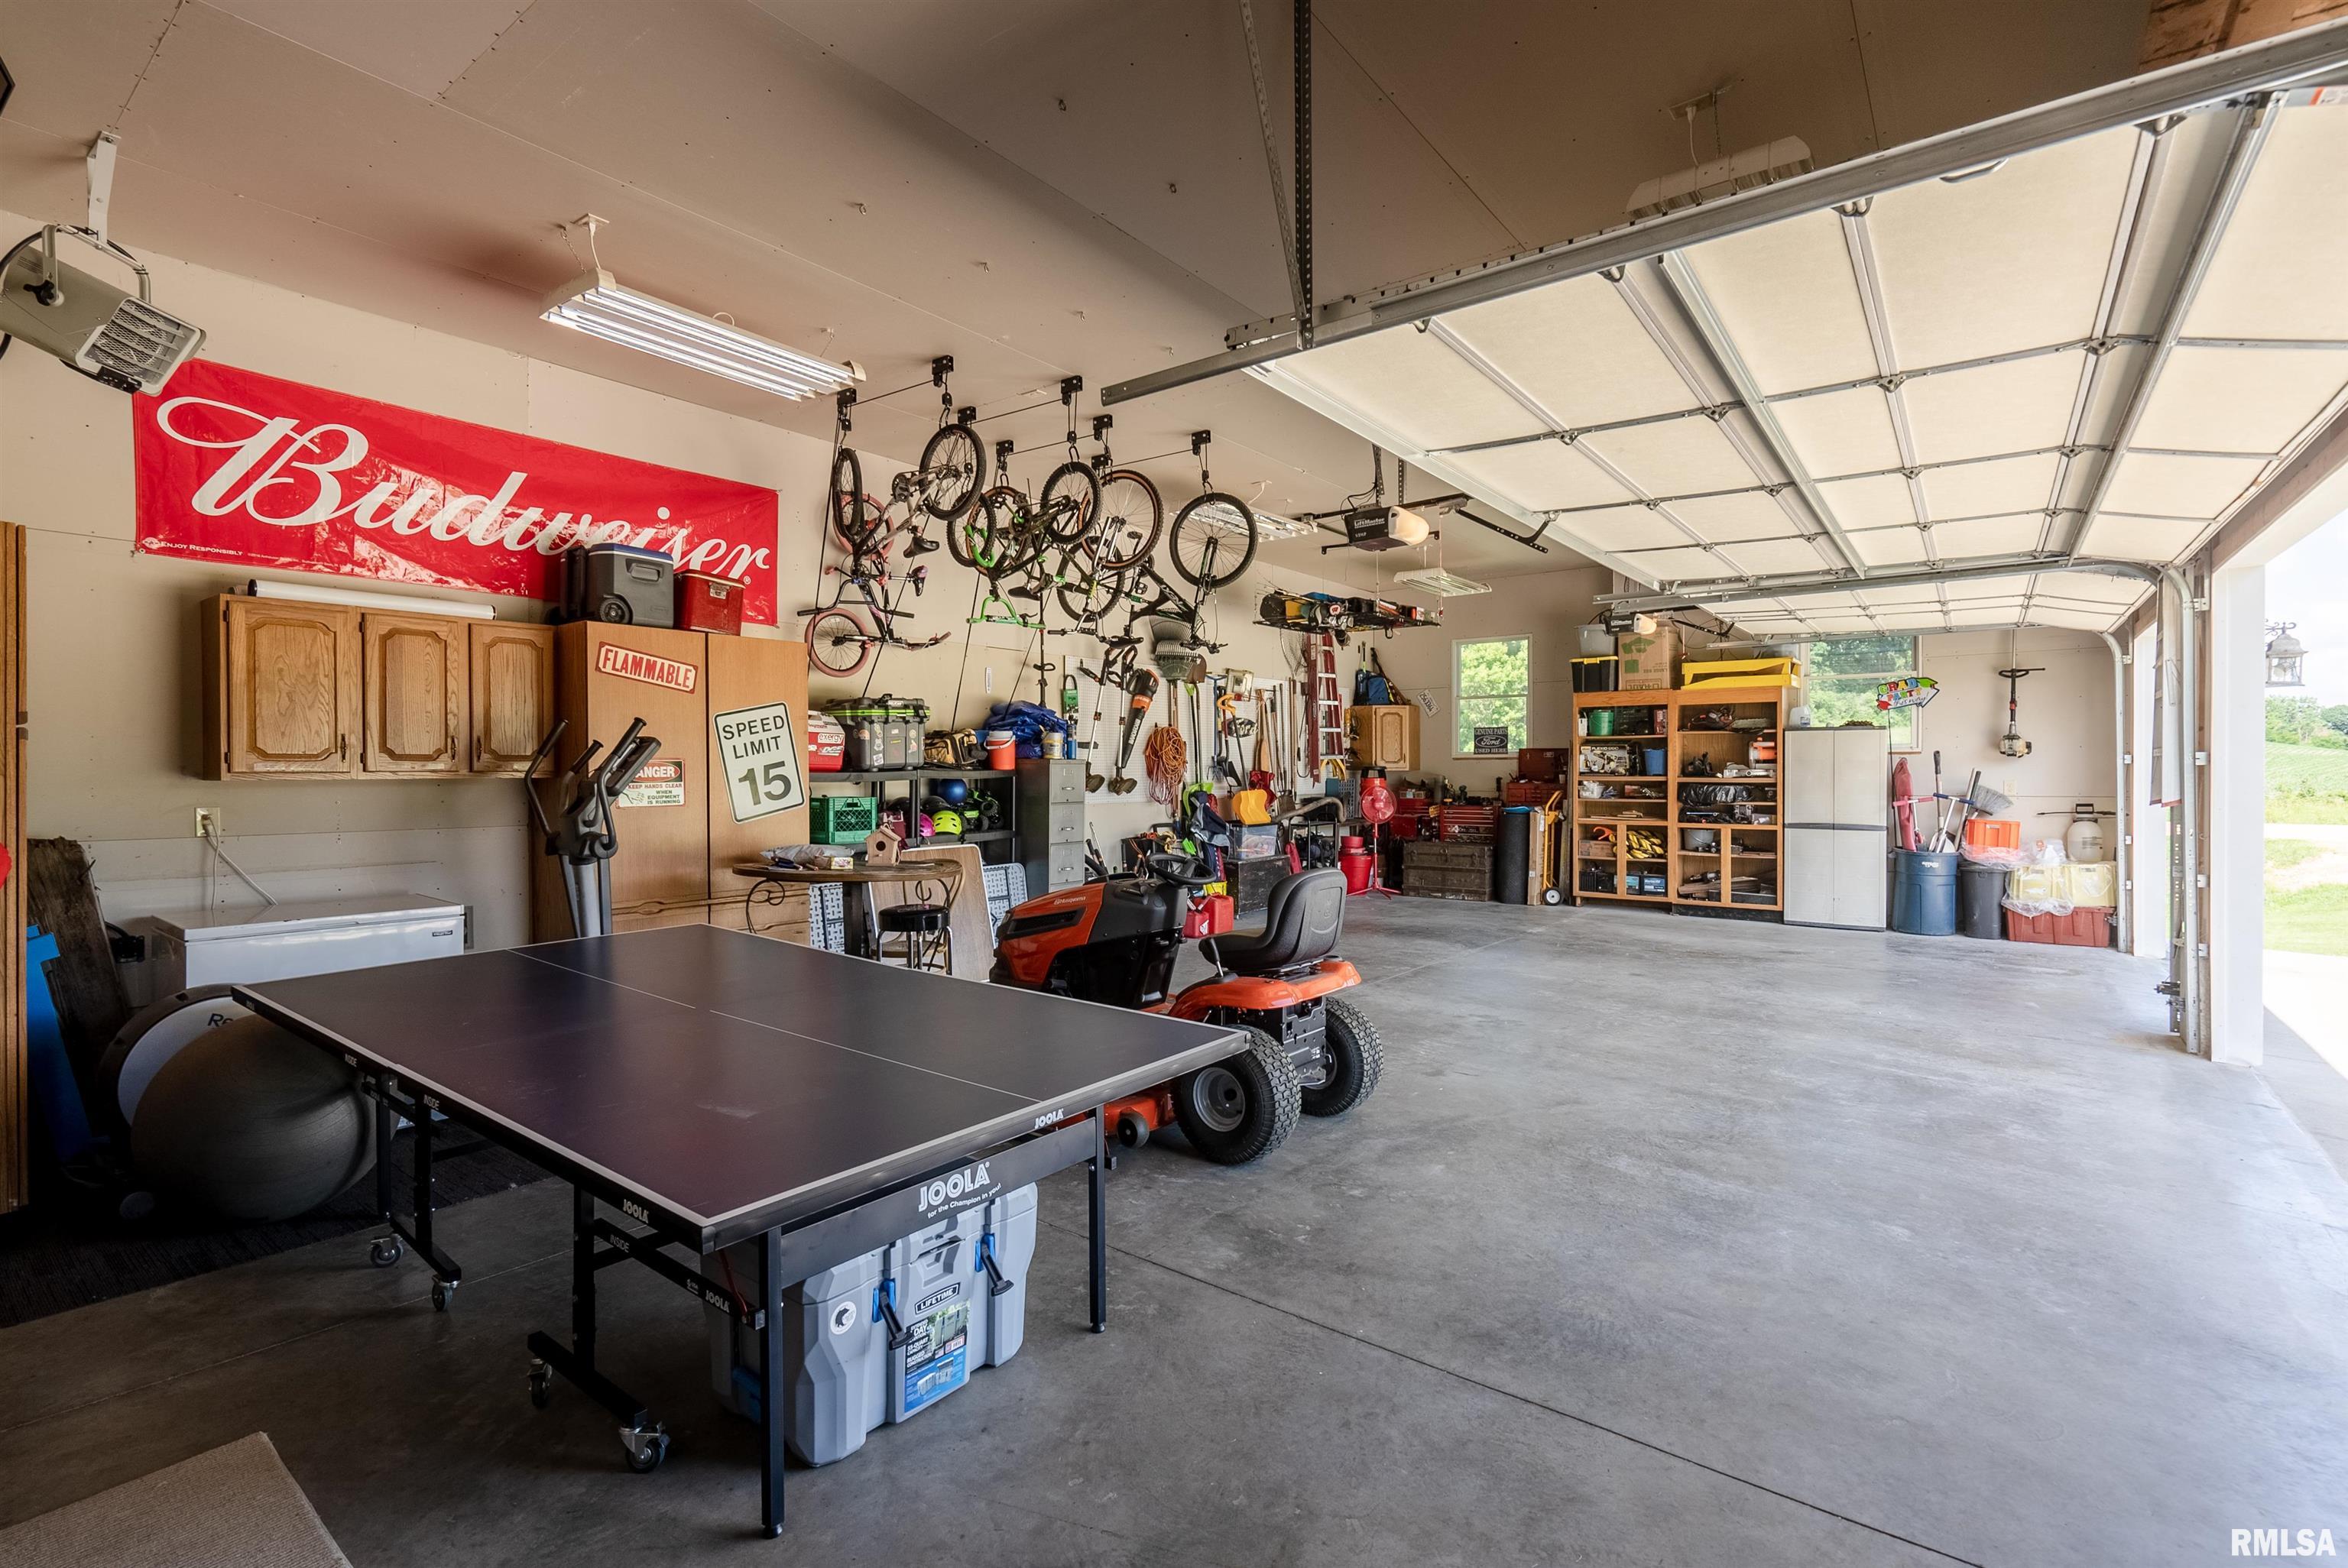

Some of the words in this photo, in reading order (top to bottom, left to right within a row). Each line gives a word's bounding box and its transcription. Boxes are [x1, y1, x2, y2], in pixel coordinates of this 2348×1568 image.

[1354, 518, 1385, 527] LiftMaster
[602, 647, 692, 688] FLAMMABLE
[1878, 678, 1918, 695] GRAD
[722, 714, 785, 740] SPEED
[732, 735, 781, 760] LIMIT
[819, 734, 842, 743] exergy
[1481, 737, 1500, 745] Ford
[635, 766, 675, 777] ANGER
[738, 760, 792, 806] 15
[1034, 1109, 1063, 1129] JOOLA
[919, 1163, 991, 1212] JOOLA
[623, 1199, 649, 1223] JOOLA
[927, 1210, 937, 1219] for
[949, 1196, 981, 1208] Champion
[988, 1183, 1001, 1197] you!
[610, 1234, 631, 1253] INSIDE
[705, 1290, 730, 1313] JOOLA
[920, 1288, 954, 1310] LIFETIME
[913, 1323, 928, 1336] DAY
